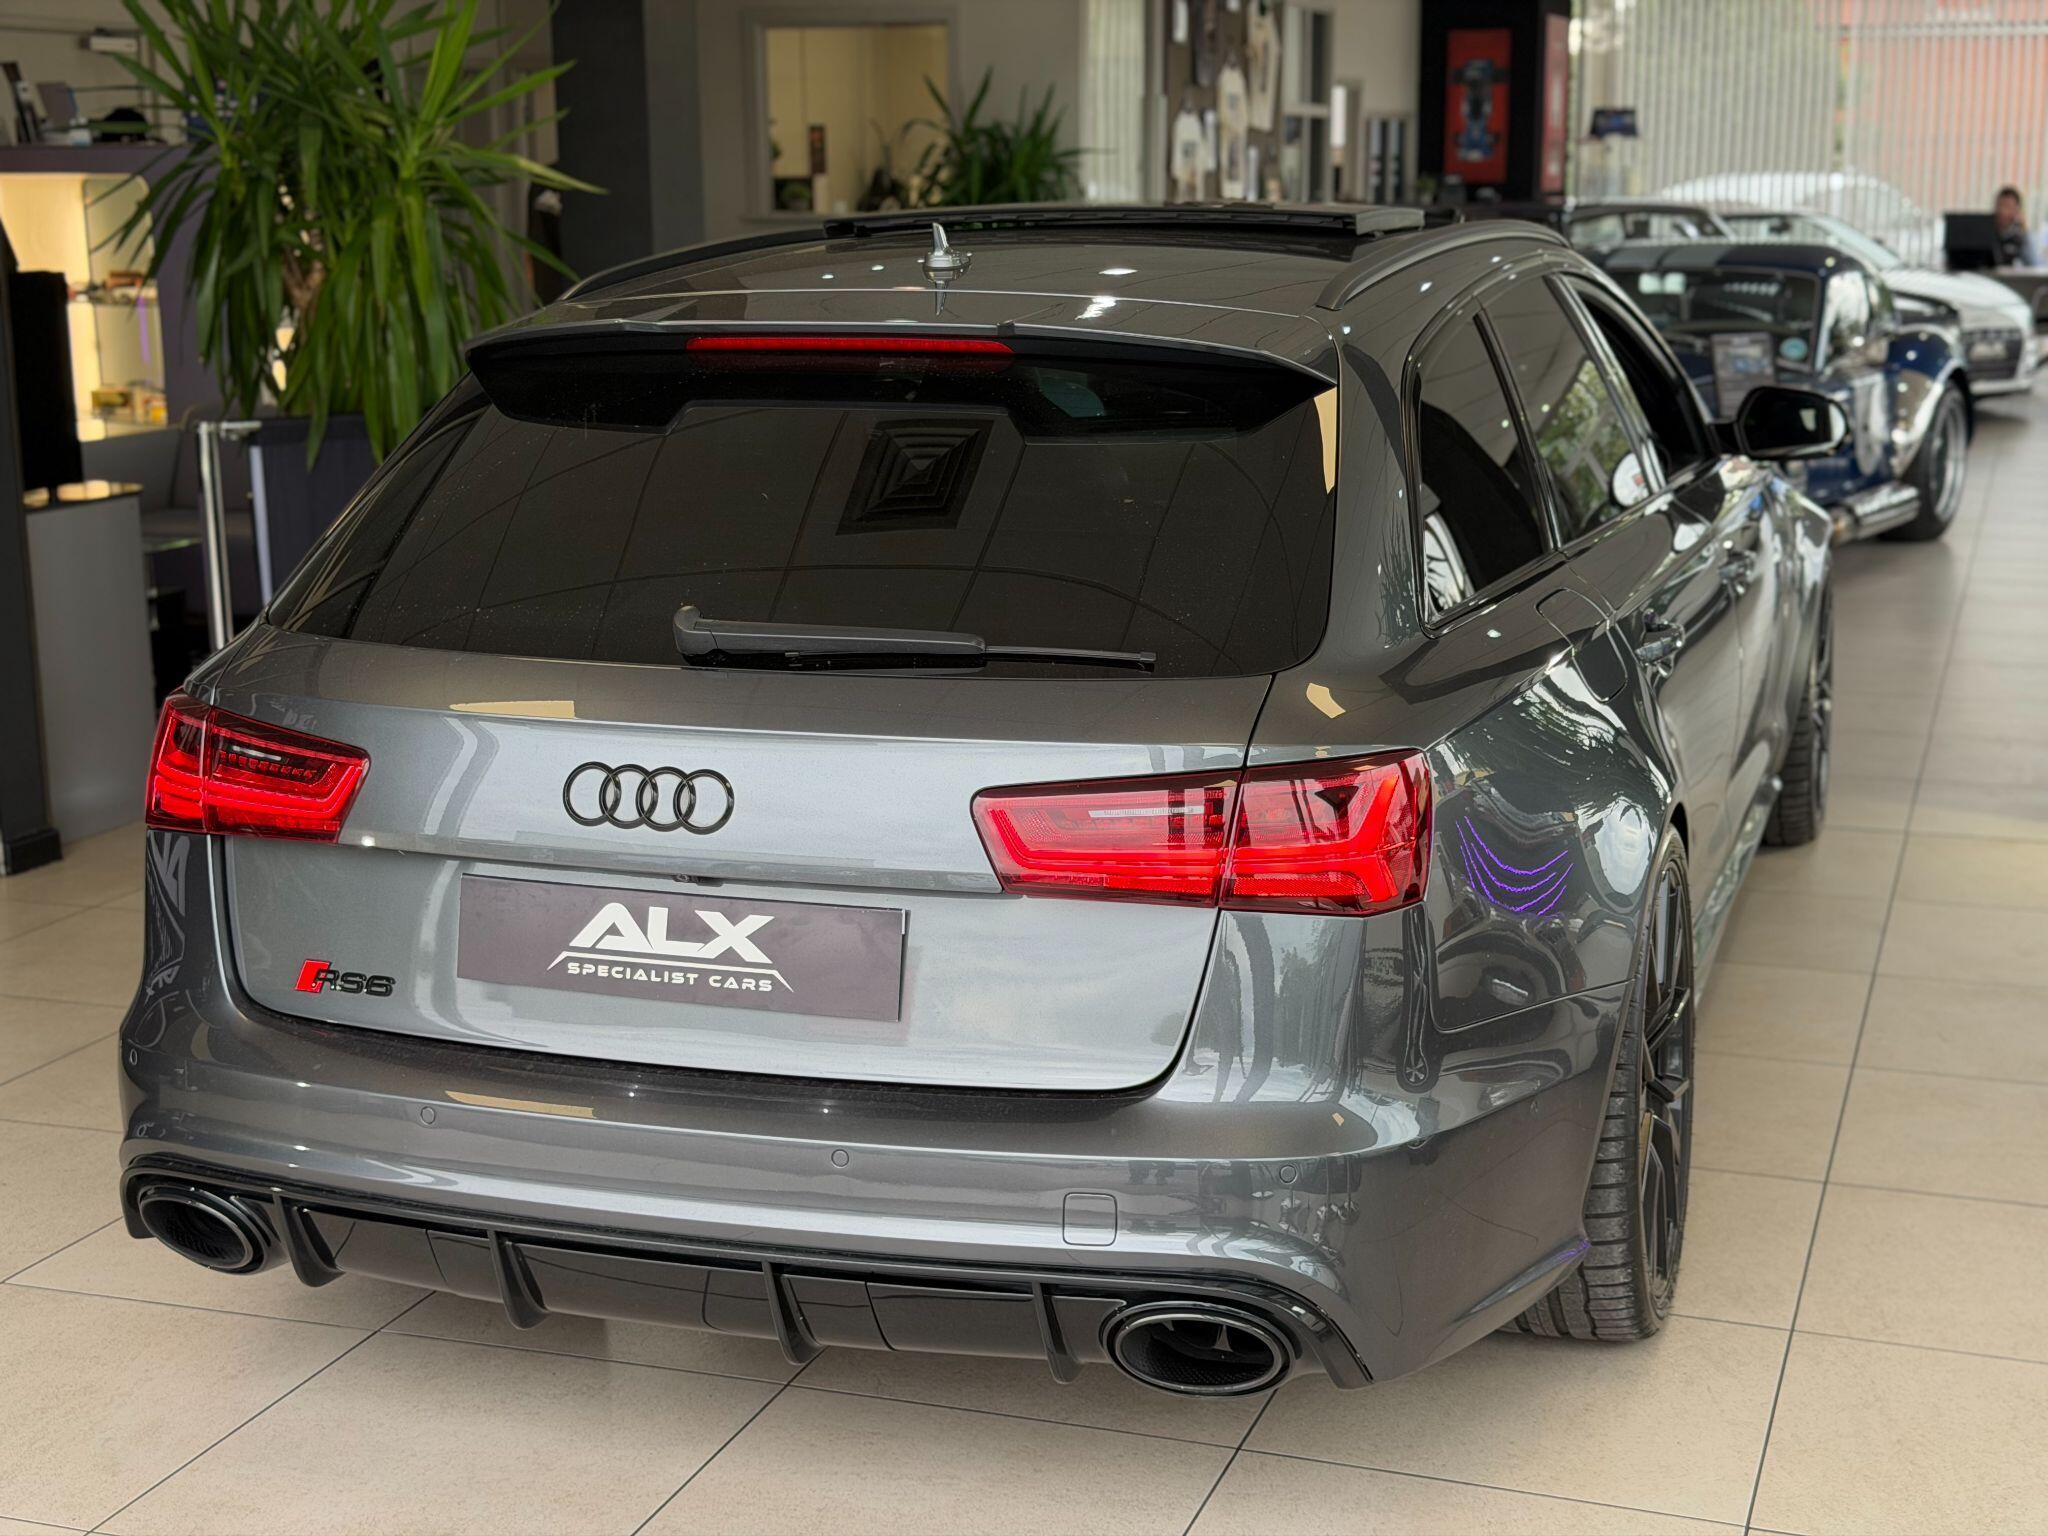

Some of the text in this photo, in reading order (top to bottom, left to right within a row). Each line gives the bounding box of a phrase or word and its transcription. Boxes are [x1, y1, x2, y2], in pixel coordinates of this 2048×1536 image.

[569, 902, 775, 964] ALX
[311, 969, 397, 997] RS6
[567, 962, 773, 992] SPECIALIST CARS
